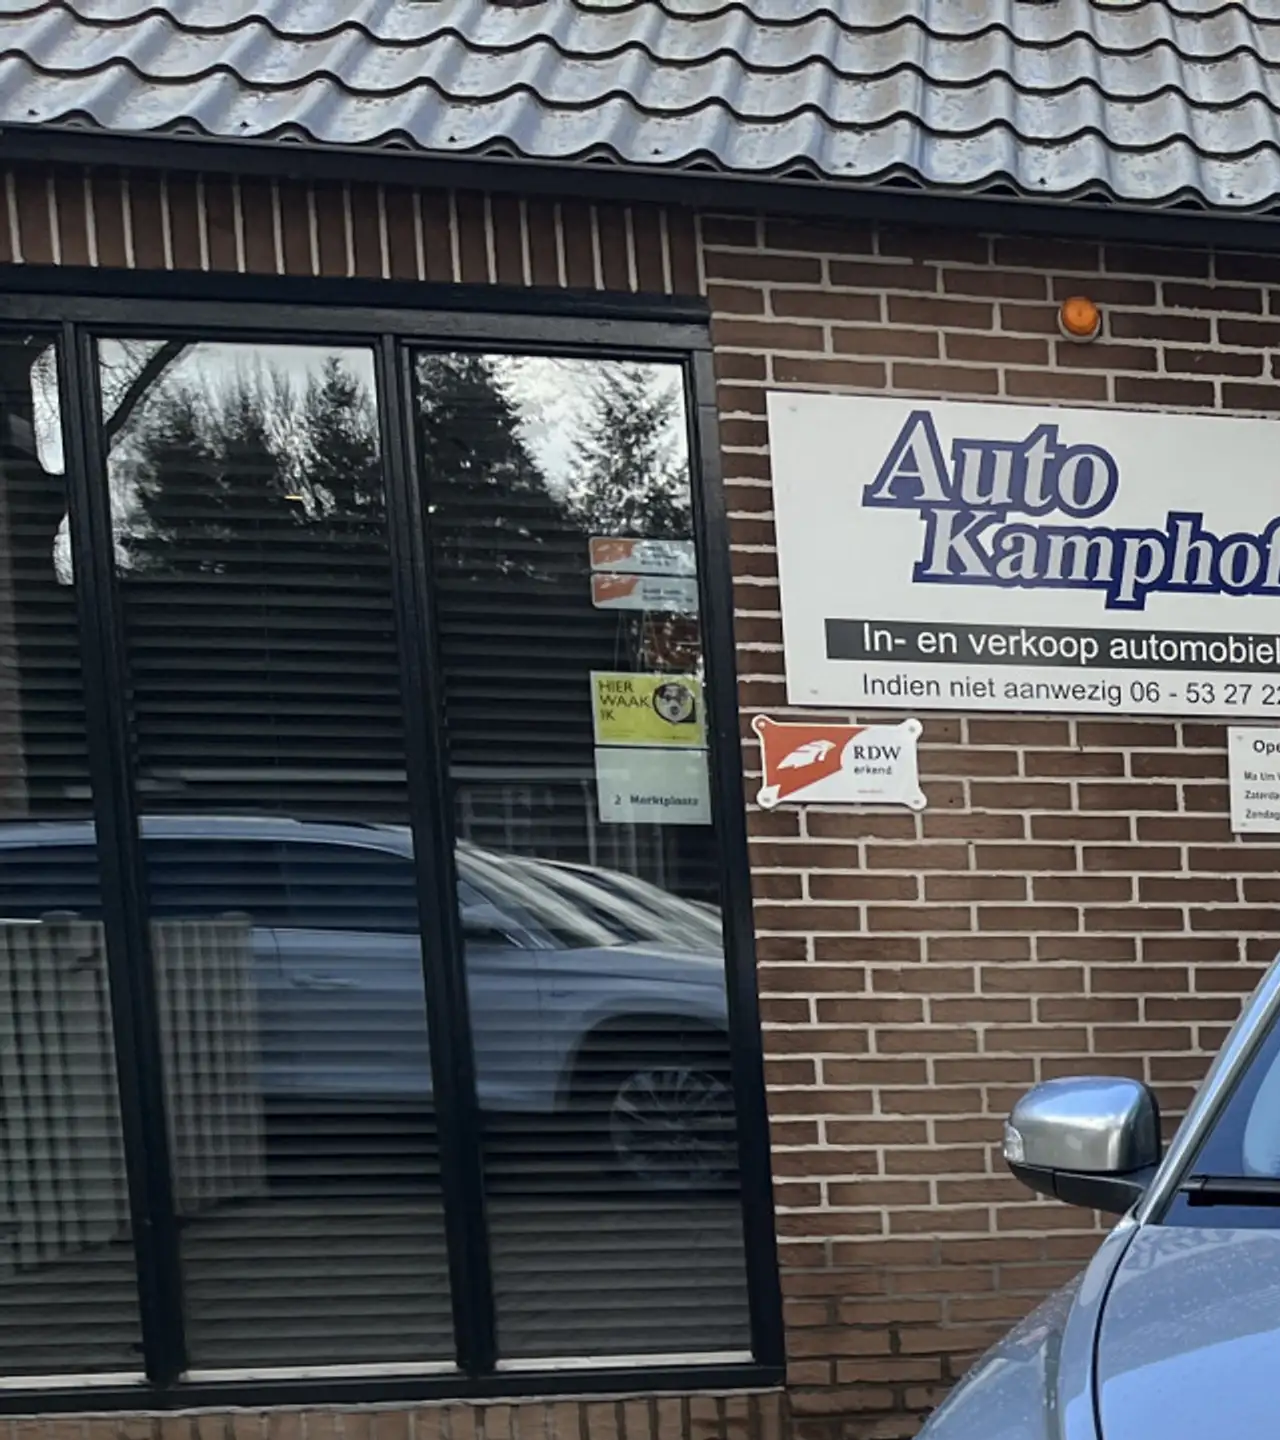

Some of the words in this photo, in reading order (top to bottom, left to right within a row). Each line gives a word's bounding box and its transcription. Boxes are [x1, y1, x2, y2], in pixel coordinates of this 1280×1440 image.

[862, 410, 1118, 517] Auto
[863, 622, 906, 652] In-
[917, 630, 958, 654] en
[967, 628, 1099, 665] verkoop
[598, 680, 633, 692] HIER
[863, 673, 940, 697] Indien
[949, 676, 996, 698] niet
[1003, 680, 1123, 707] aanwezig
[1130, 681, 1160, 703] 06
[1185, 682, 1216, 704] 53
[1223, 683, 1253, 705] 27
[600, 695, 650, 708] WAAK
[600, 709, 615, 721] IK
[854, 745, 902, 761] RDW
[853, 765, 892, 775] erkend
